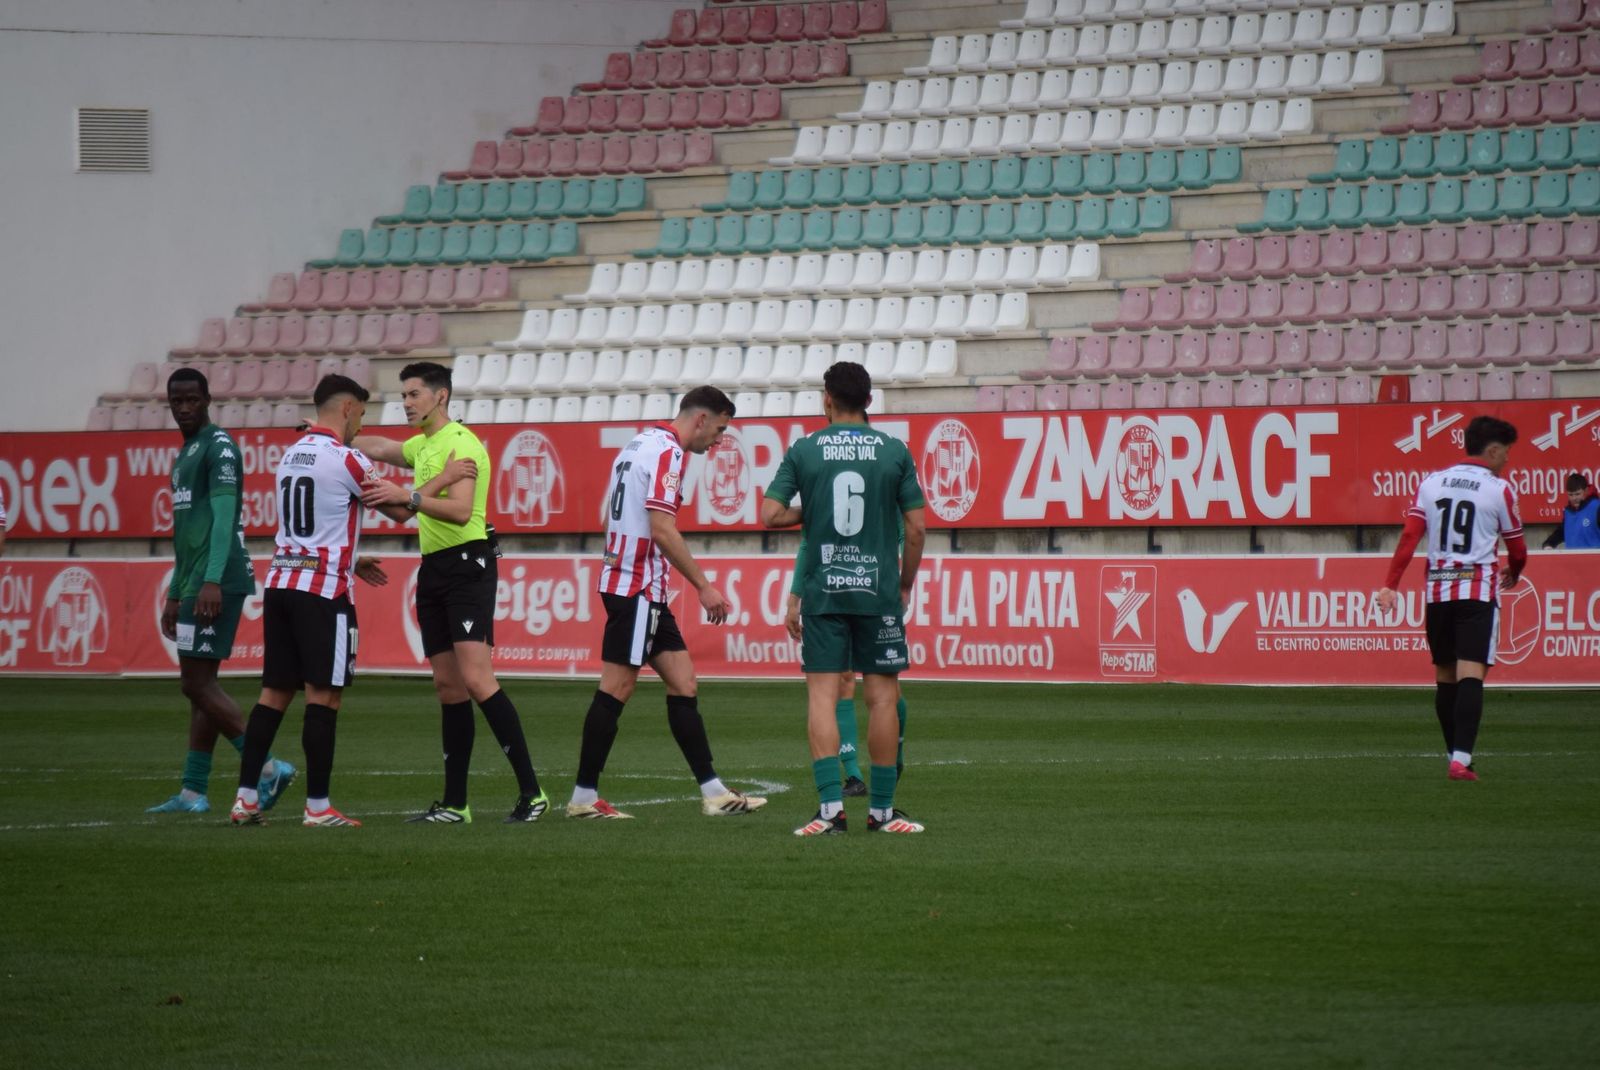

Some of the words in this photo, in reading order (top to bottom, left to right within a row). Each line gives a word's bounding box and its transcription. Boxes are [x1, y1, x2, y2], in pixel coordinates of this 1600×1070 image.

[823, 435, 884, 445] ABANCA
[823, 445, 856, 460] BRAIS
[858, 445, 877, 460] VAL
[1003, 415, 1247, 520] ZAMORA
[1251, 412, 1339, 519] CF
[280, 475, 315, 538] 10
[833, 471, 865, 537] 6
[1435, 497, 1476, 555] 19
[843, 554, 878, 564] GALICIA
[942, 570, 978, 627] LA
[988, 570, 1080, 628] PLATA
[1256, 591, 1426, 628] VALDERADU
[498, 647, 533, 660] FOODS
[537, 647, 591, 661] COMPANY
[935, 634, 1055, 671] (Zamora)
[1102, 651, 1155, 672] RepoSTAR
[1257, 638, 1271, 651] EL
[1274, 637, 1320, 651] CENTRO
[1323, 637, 1391, 651] COMERCIAL
[1394, 637, 1409, 651] DE
